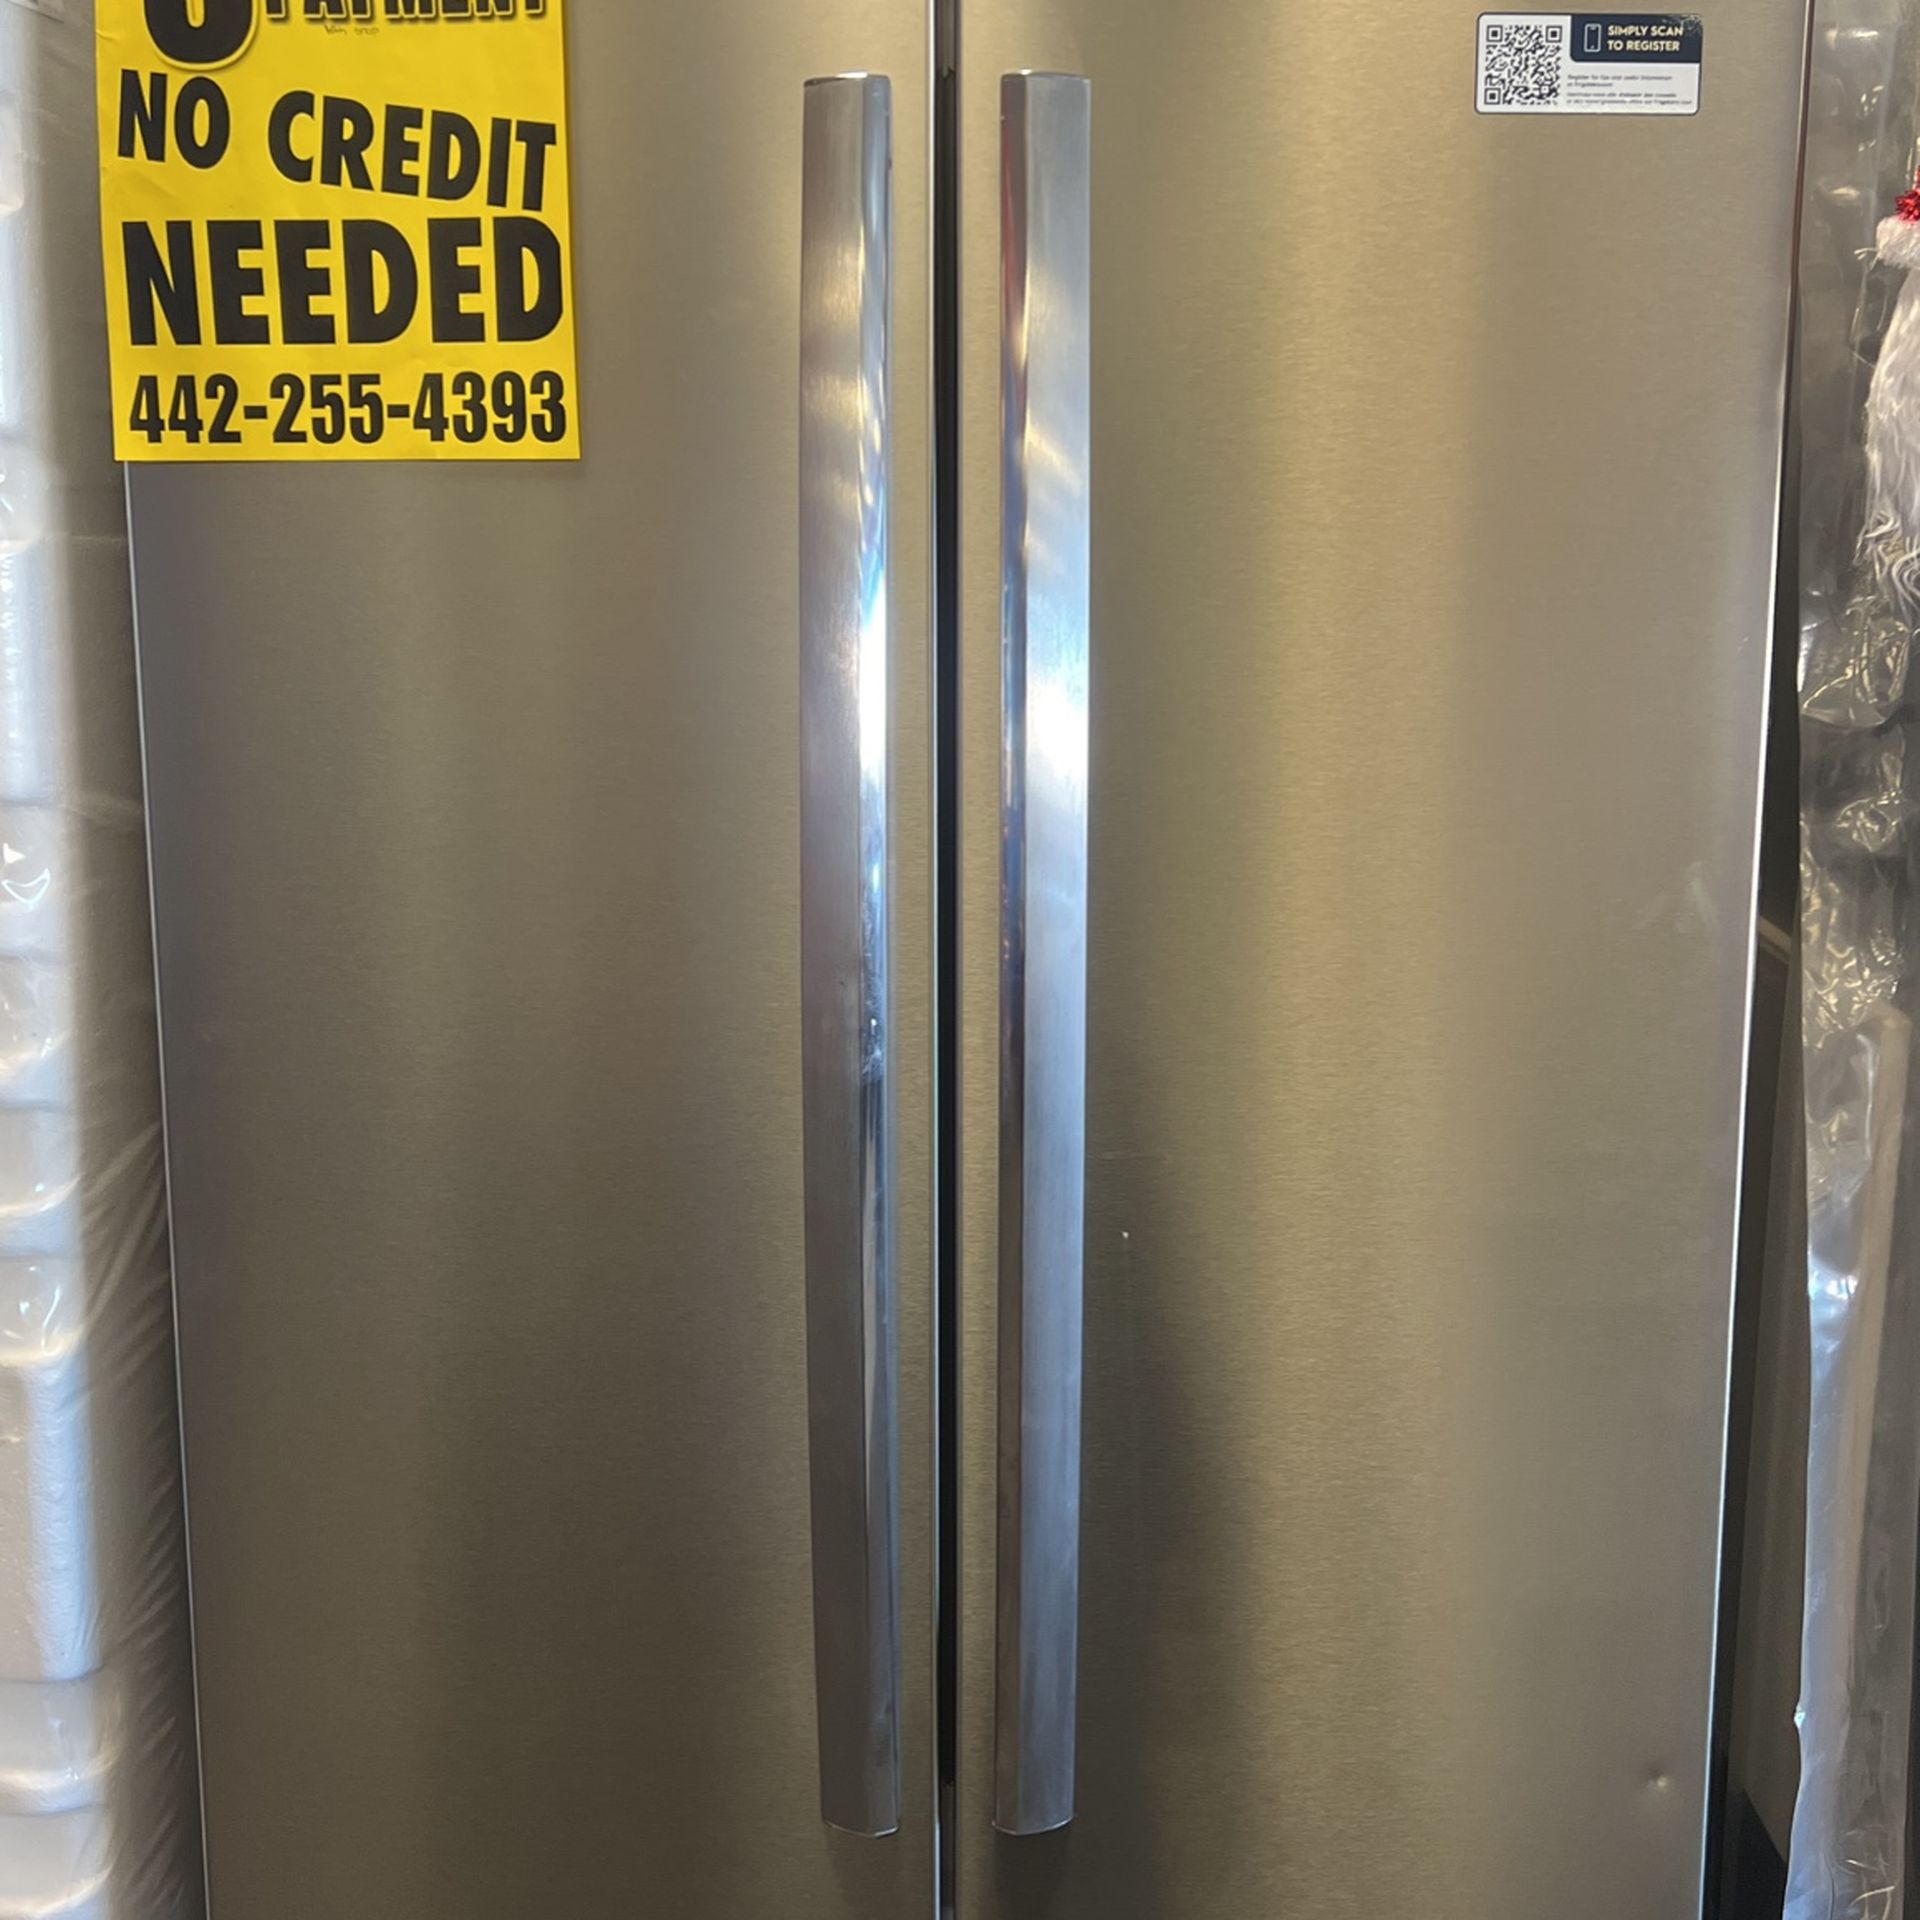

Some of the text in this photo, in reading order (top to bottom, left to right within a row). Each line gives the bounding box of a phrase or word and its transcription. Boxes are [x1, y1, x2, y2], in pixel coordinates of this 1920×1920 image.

[1607, 25, 1684, 36] SIMPLY SCAN
[1607, 40, 1680, 52] TO REGISTER
[117, 68, 557, 212] NO CREDIT
[121, 216, 563, 346] NEEDED
[129, 370, 567, 444] 442-255-4393
